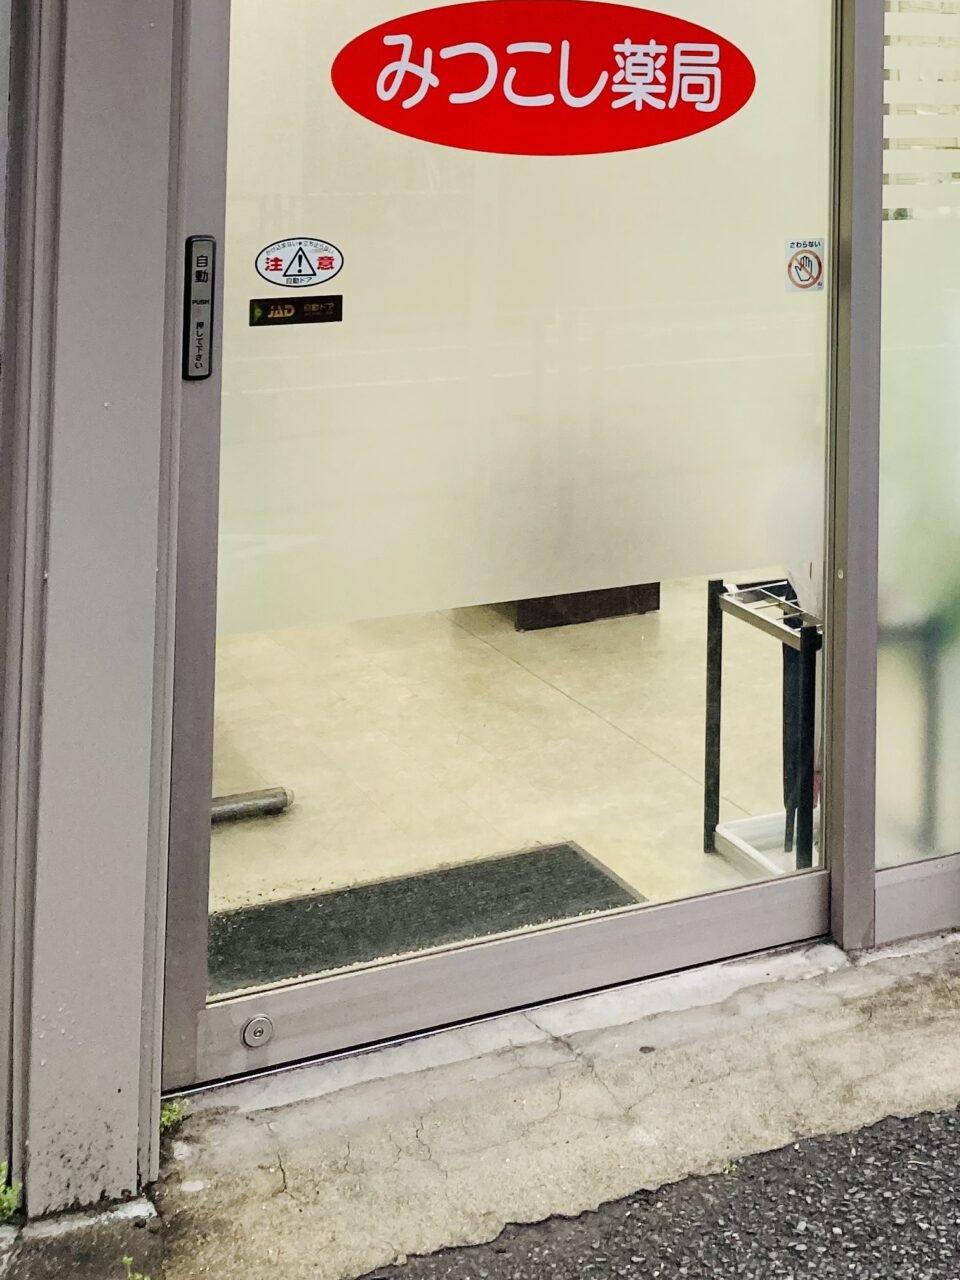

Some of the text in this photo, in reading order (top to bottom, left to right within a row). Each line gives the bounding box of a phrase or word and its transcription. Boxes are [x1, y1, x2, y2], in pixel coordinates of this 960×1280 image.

[376, 34, 722, 112] みつこし薬局
[789, 240, 821, 249] さわらない
[194, 254, 209, 283] 自動
